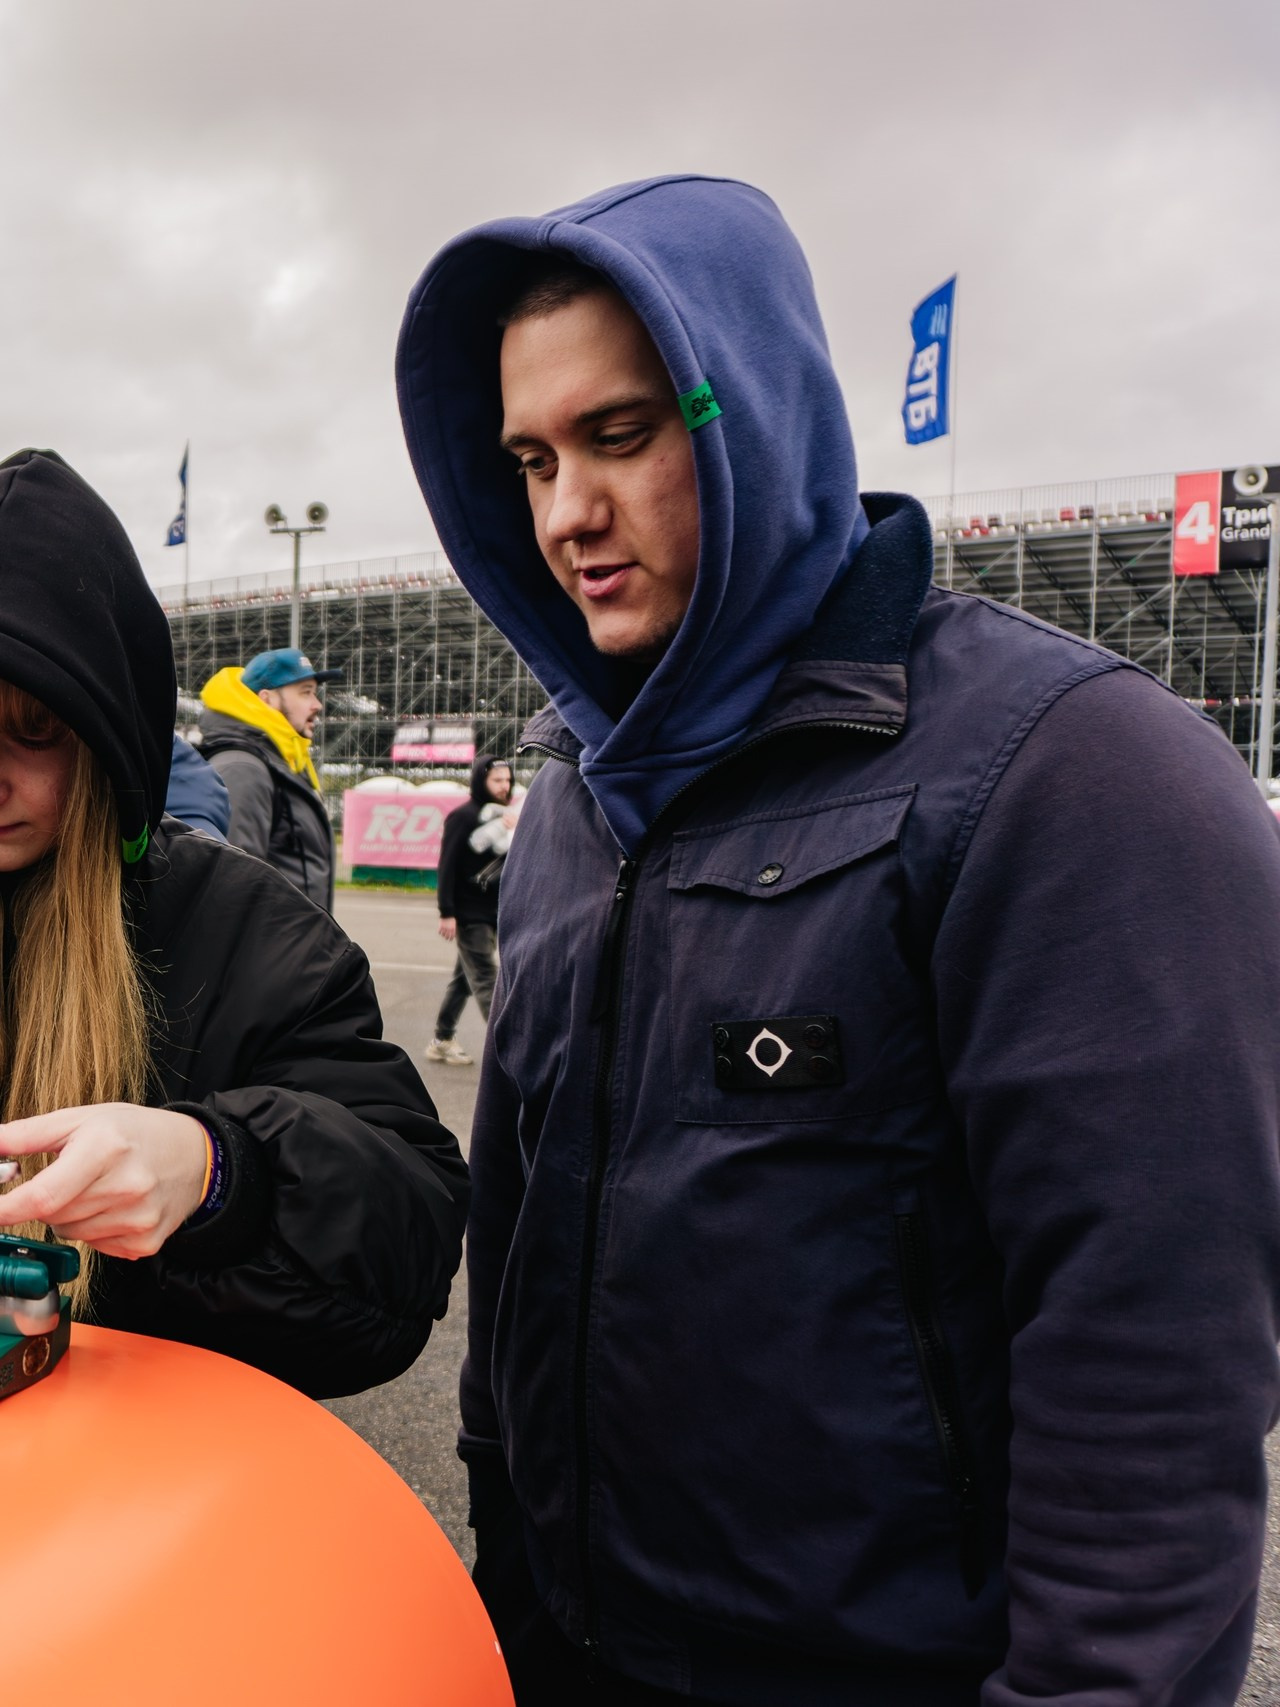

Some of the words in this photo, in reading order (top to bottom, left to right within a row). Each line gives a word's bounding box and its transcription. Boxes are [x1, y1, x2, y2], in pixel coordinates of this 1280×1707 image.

[907, 341, 940, 431] ВТБ
[1177, 500, 1216, 545] 4
[1221, 523, 1270, 543] Grand
[364, 804, 443, 842] RD
